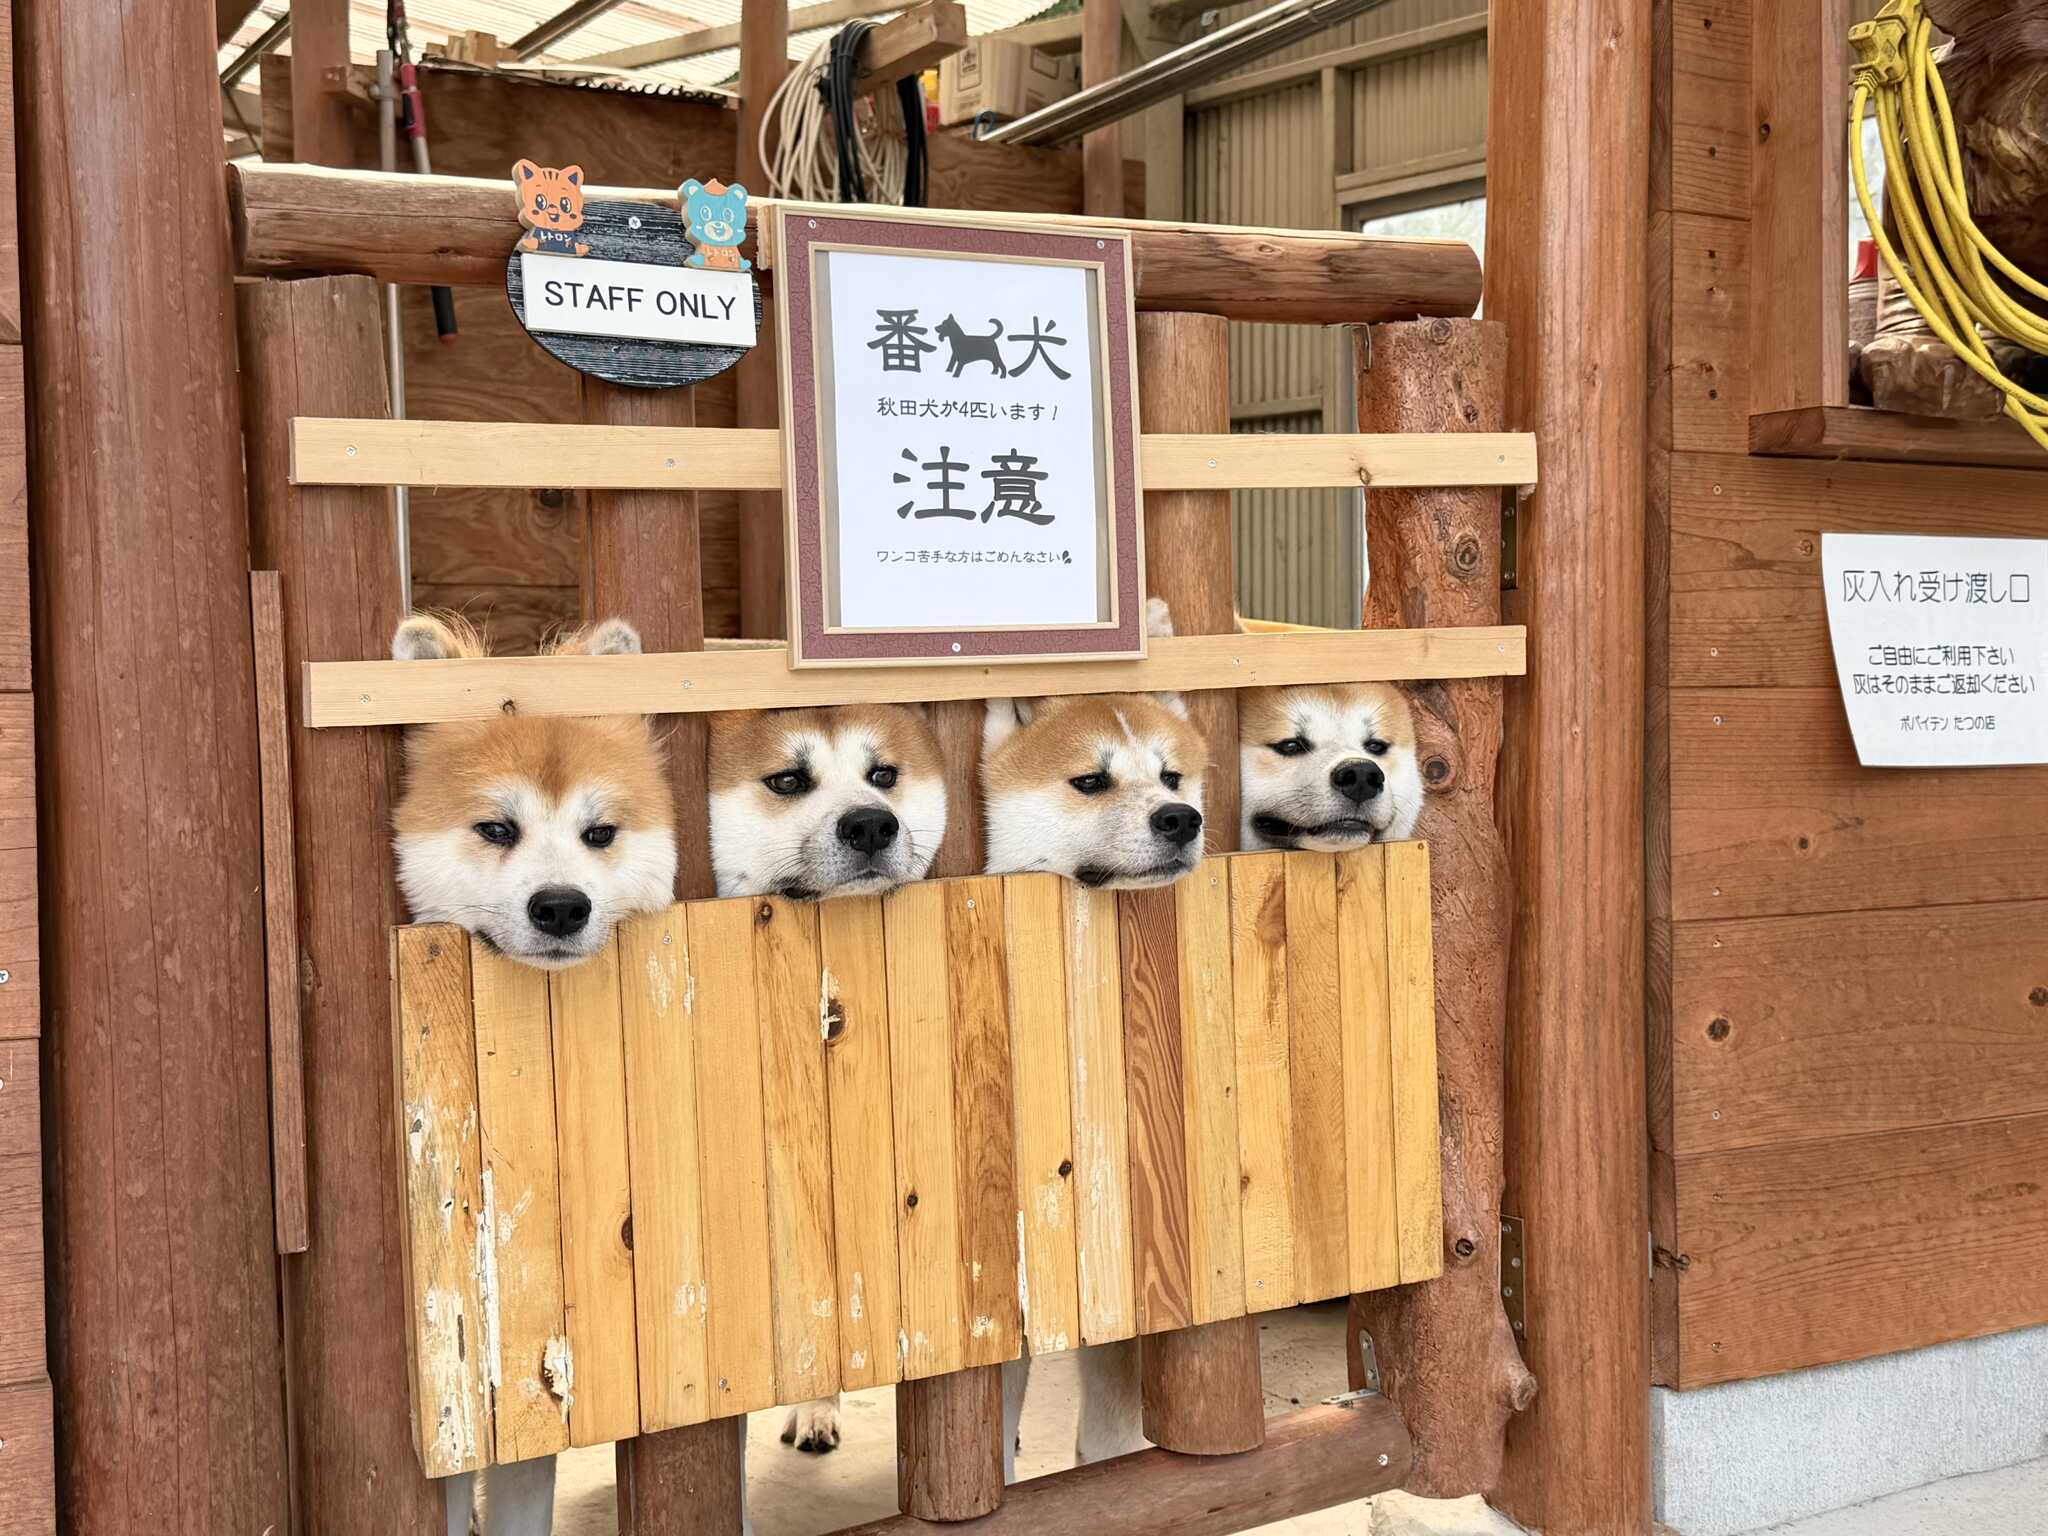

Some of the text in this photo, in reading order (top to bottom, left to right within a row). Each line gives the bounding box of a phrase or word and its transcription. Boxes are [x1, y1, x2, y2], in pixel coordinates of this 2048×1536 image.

[545, 281, 736, 320] STAFF ONLY
[893, 445, 1056, 526] 注意
[877, 550, 1061, 564] ワンコ苦手な方はごめんなさい
[1843, 570, 2030, 604] 灰入れ受け渡し口
[1868, 643, 2015, 667] ご自由にご利用下さい
[1853, 673, 2035, 695] 灰はそのままご返却ください
